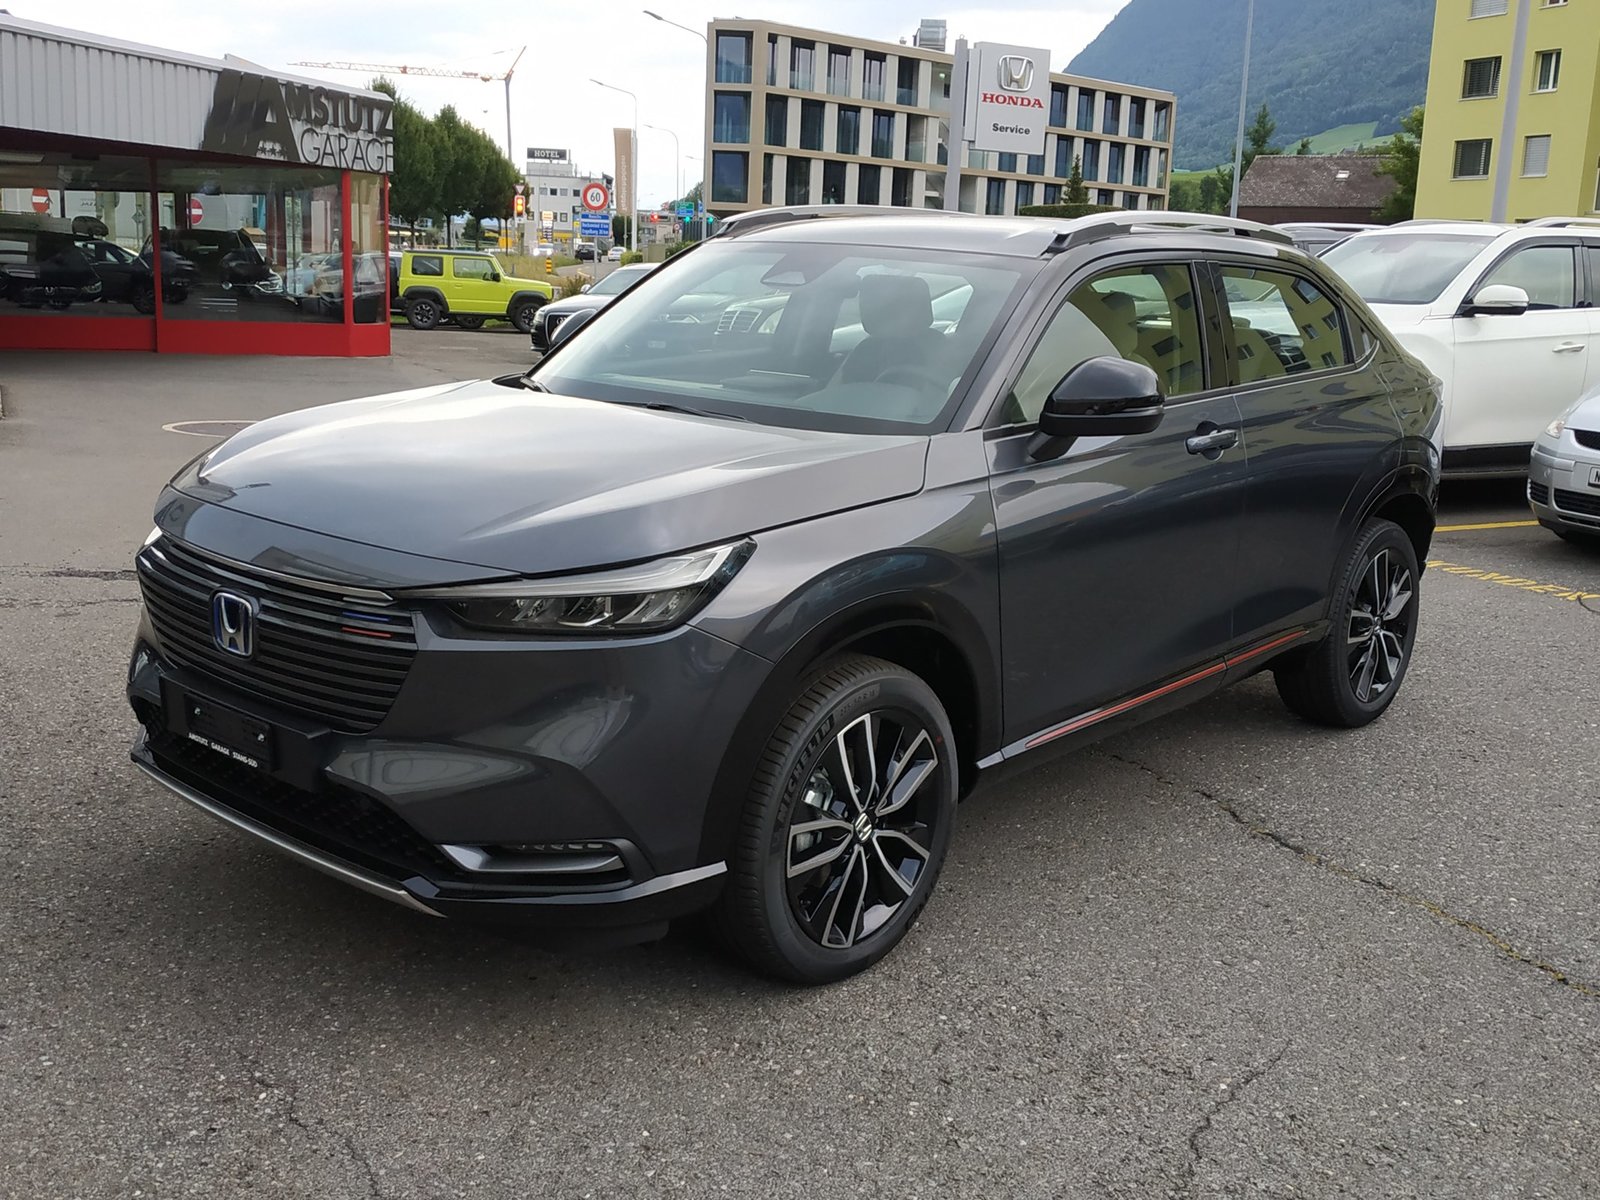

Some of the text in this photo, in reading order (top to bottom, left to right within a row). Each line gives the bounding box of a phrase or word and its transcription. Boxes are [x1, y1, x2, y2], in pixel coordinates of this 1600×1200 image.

[981, 92, 1044, 109] HONDA
[992, 122, 1031, 135] Service
[300, 127, 394, 173] GARAGE
[534, 150, 560, 158] HOTEL
[590, 191, 601, 202] 60
[211, 742, 230, 756] GARAGE
